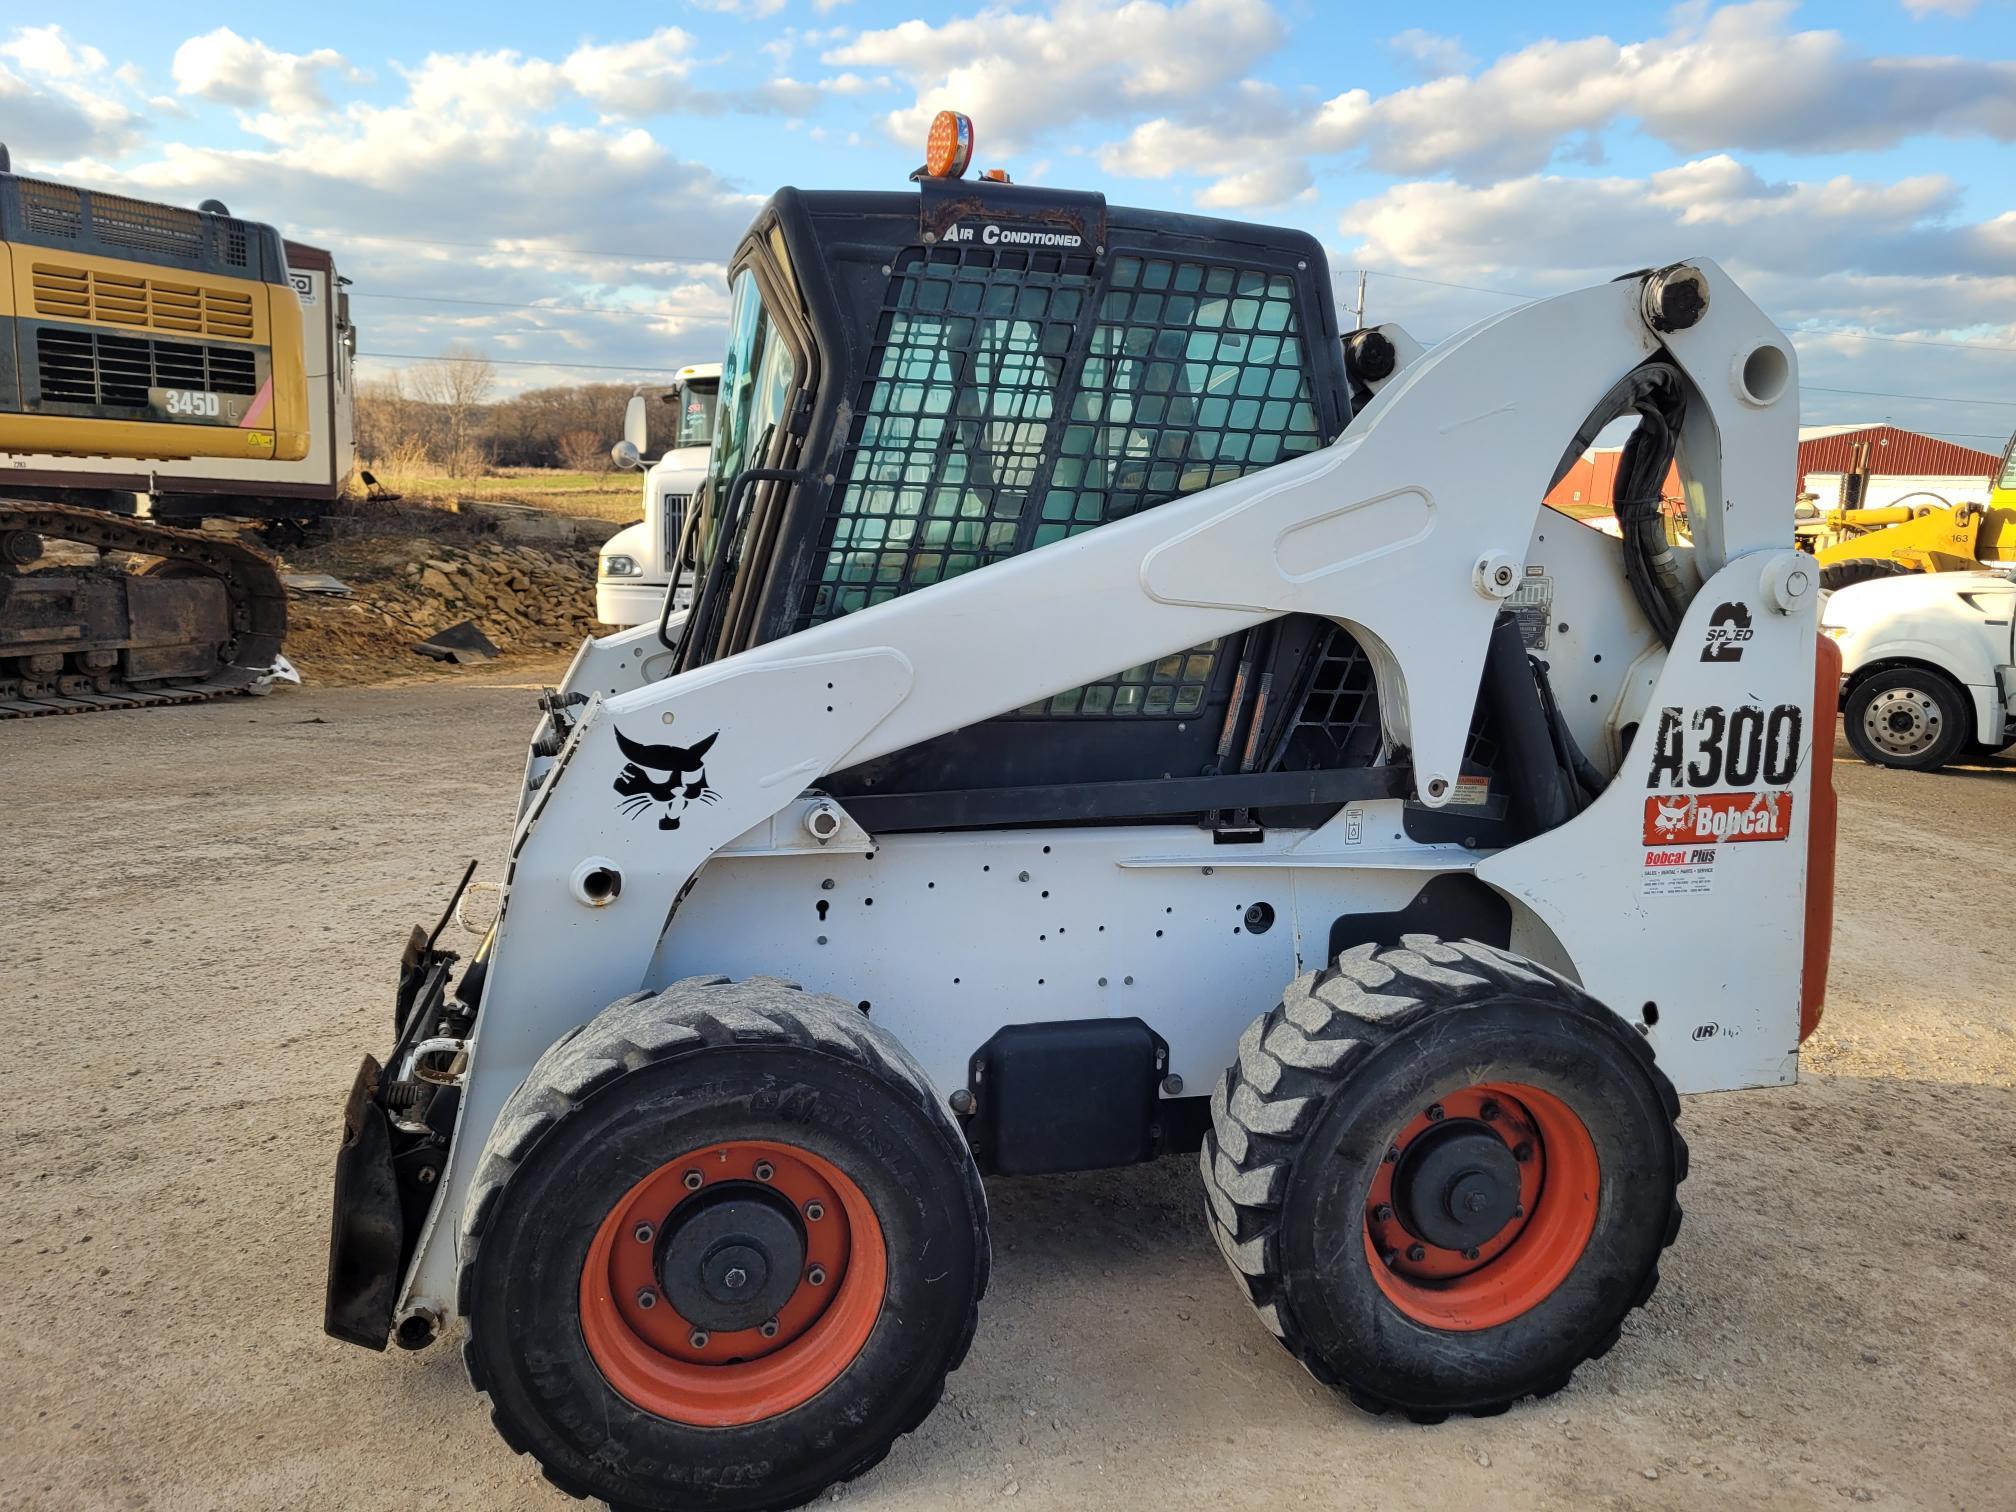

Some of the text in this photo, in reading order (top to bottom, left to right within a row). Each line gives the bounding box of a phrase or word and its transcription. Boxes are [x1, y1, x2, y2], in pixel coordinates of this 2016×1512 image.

[943, 224, 1081, 247] AIR CONDITIONED
[166, 390, 219, 416] 345D
[1951, 534, 1969, 542] 163
[1700, 601, 1753, 662] 2
[1646, 704, 1803, 789] A300
[1695, 805, 1779, 836] Bobcat
[1645, 850, 1716, 865] Bobcat Plus
[1695, 1025, 1716, 1039] IR
